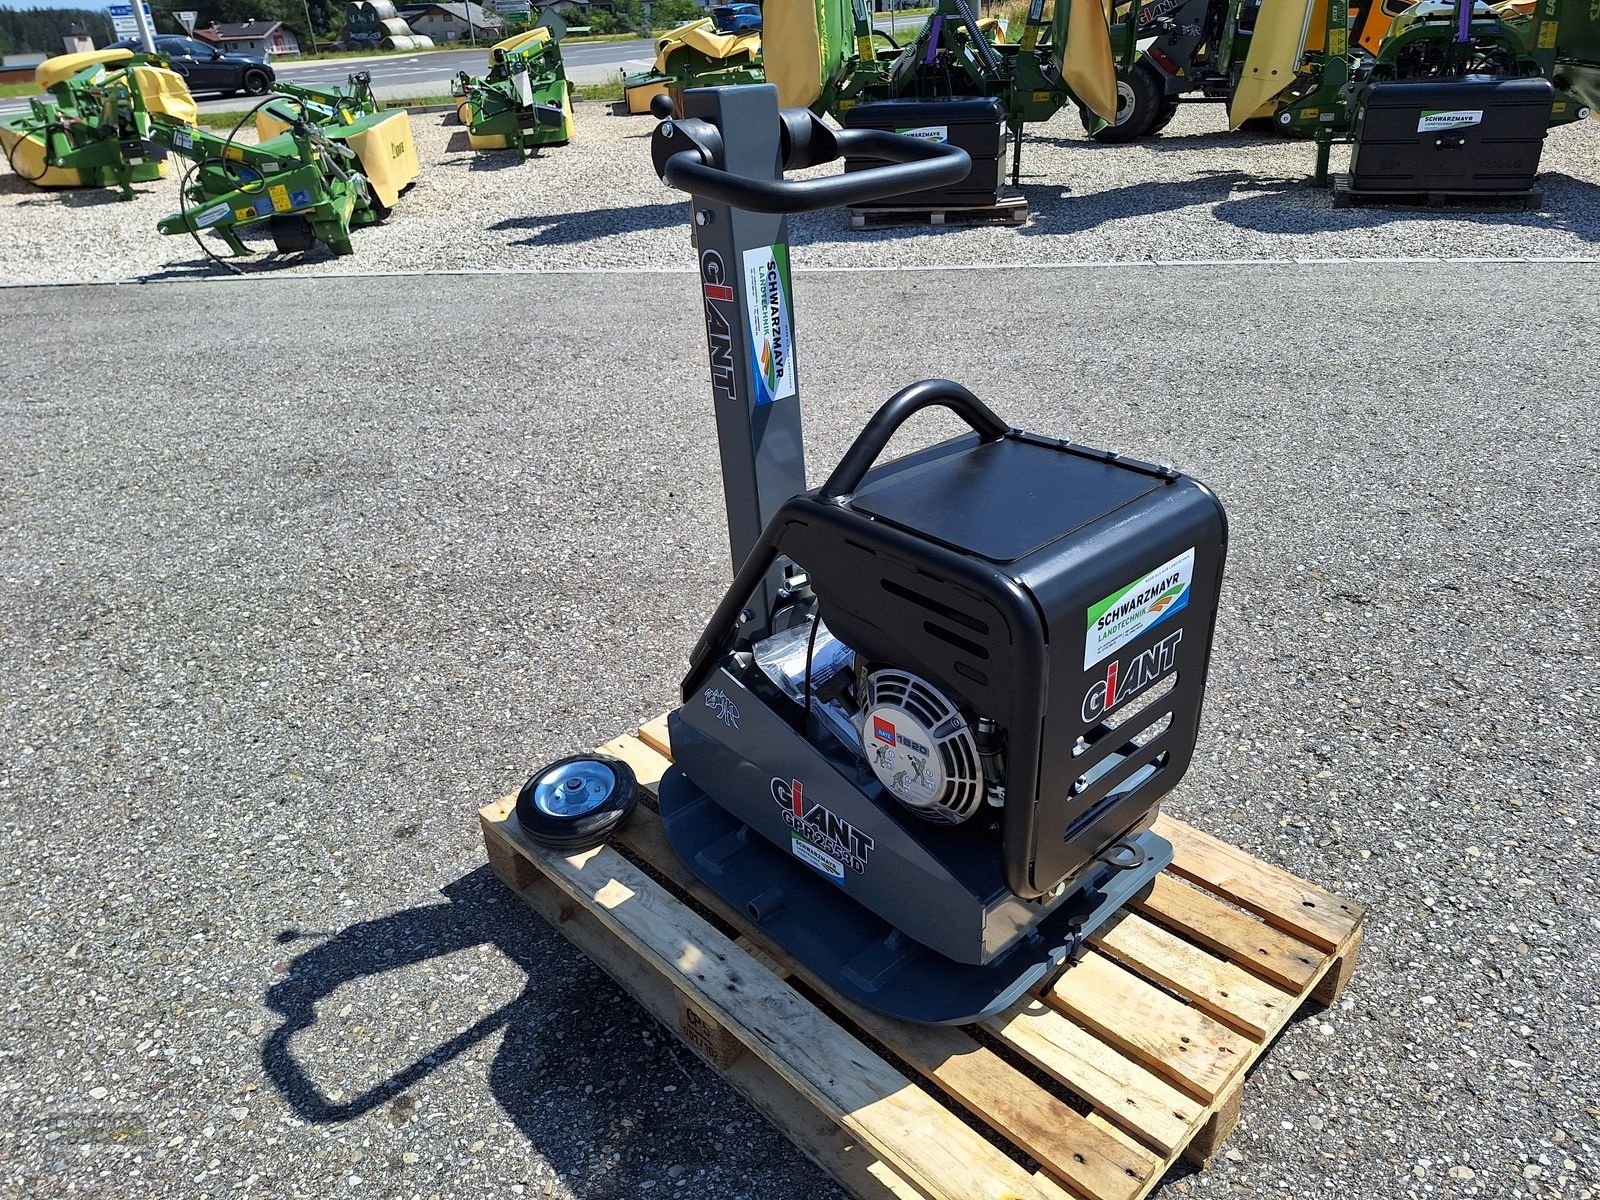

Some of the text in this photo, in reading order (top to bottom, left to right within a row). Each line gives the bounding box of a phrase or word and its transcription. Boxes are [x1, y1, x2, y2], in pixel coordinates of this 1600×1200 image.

[701, 248, 737, 401] GIANT
[758, 265, 771, 336] LANDTECHNIK
[766, 261, 784, 379] SCHWARZMAYR
[1097, 572, 1180, 631] SCHWARZMAYR
[1097, 607, 1147, 643] LANDTECHNIK
[1081, 628, 1183, 723] GIANT
[770, 776, 876, 864] GIANT
[782, 808, 866, 875] GPR2553D
